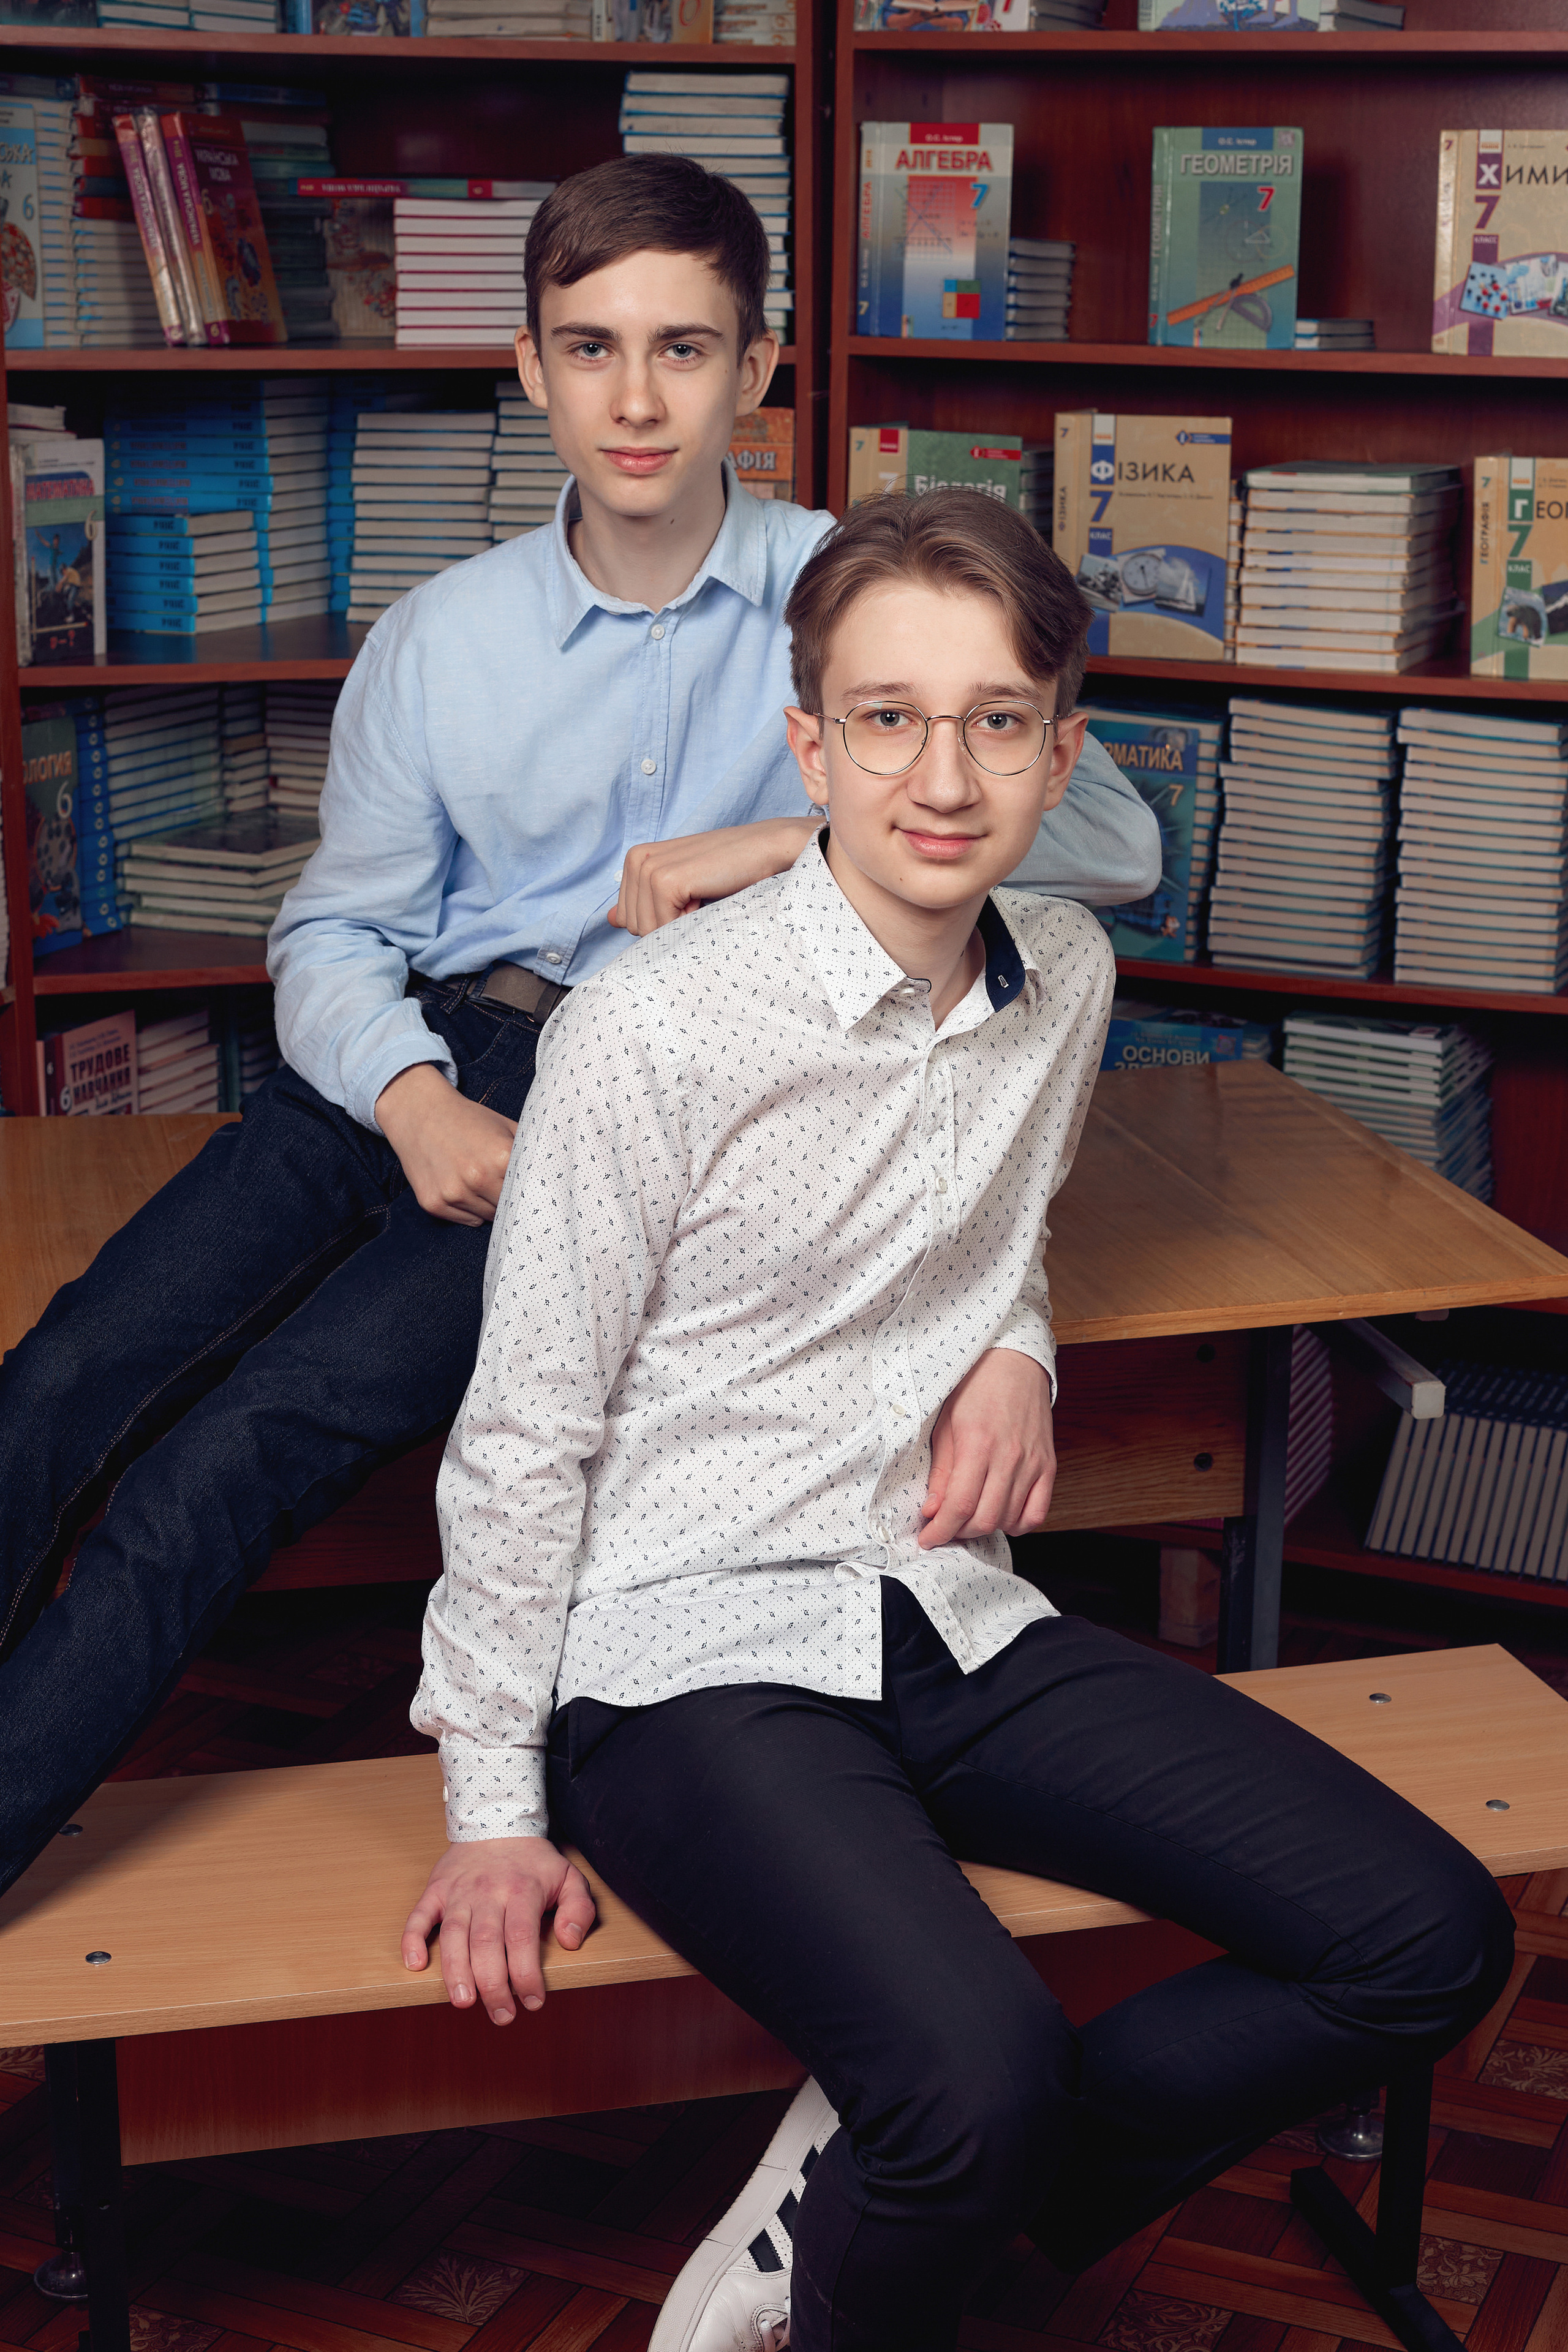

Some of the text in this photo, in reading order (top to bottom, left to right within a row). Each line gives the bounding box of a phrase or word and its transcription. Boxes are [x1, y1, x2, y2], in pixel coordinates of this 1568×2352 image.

[1444, 140, 1454, 151] 7
[894, 149, 993, 171] АЛГЕБРА
[1180, 153, 1294, 176] ГЕОМЕТРІЯ
[23, 194, 34, 220] 6
[201, 189, 213, 216] 6
[971, 183, 989, 209] 7
[1257, 186, 1276, 213] 7
[861, 181, 872, 239] АЛГЕБРА
[1152, 184, 1163, 258] ГЕОМЕТРІЯ
[1474, 195, 1501, 230] 7
[859, 301, 870, 315] 7
[1149, 314, 1159, 328] 7
[1060, 428, 1069, 438] 7
[855, 440, 864, 451] 7
[727, 449, 776, 470] ФІЯ
[1090, 460, 1195, 483] ФІЗИКА
[26, 478, 96, 501] МАТЕМАТИКА
[1481, 476, 1491, 488] 7
[1058, 487, 1067, 531] ФІЗИКА
[1090, 491, 1113, 522] 7
[85, 509, 97, 541] 6
[1090, 532, 1112, 540] КЛАС
[1480, 502, 1490, 565] ГЕОГРАФІЯ
[1507, 525, 1532, 558] 7
[1508, 565, 1531, 573] КЛАС
[56, 780, 72, 819] 6
[1168, 784, 1184, 807] 7
[71, 1044, 129, 1082] ТРУДОВЕ
[1121, 1045, 1211, 1065] ОСНОВИ
[61, 1085, 72, 1112] 6
